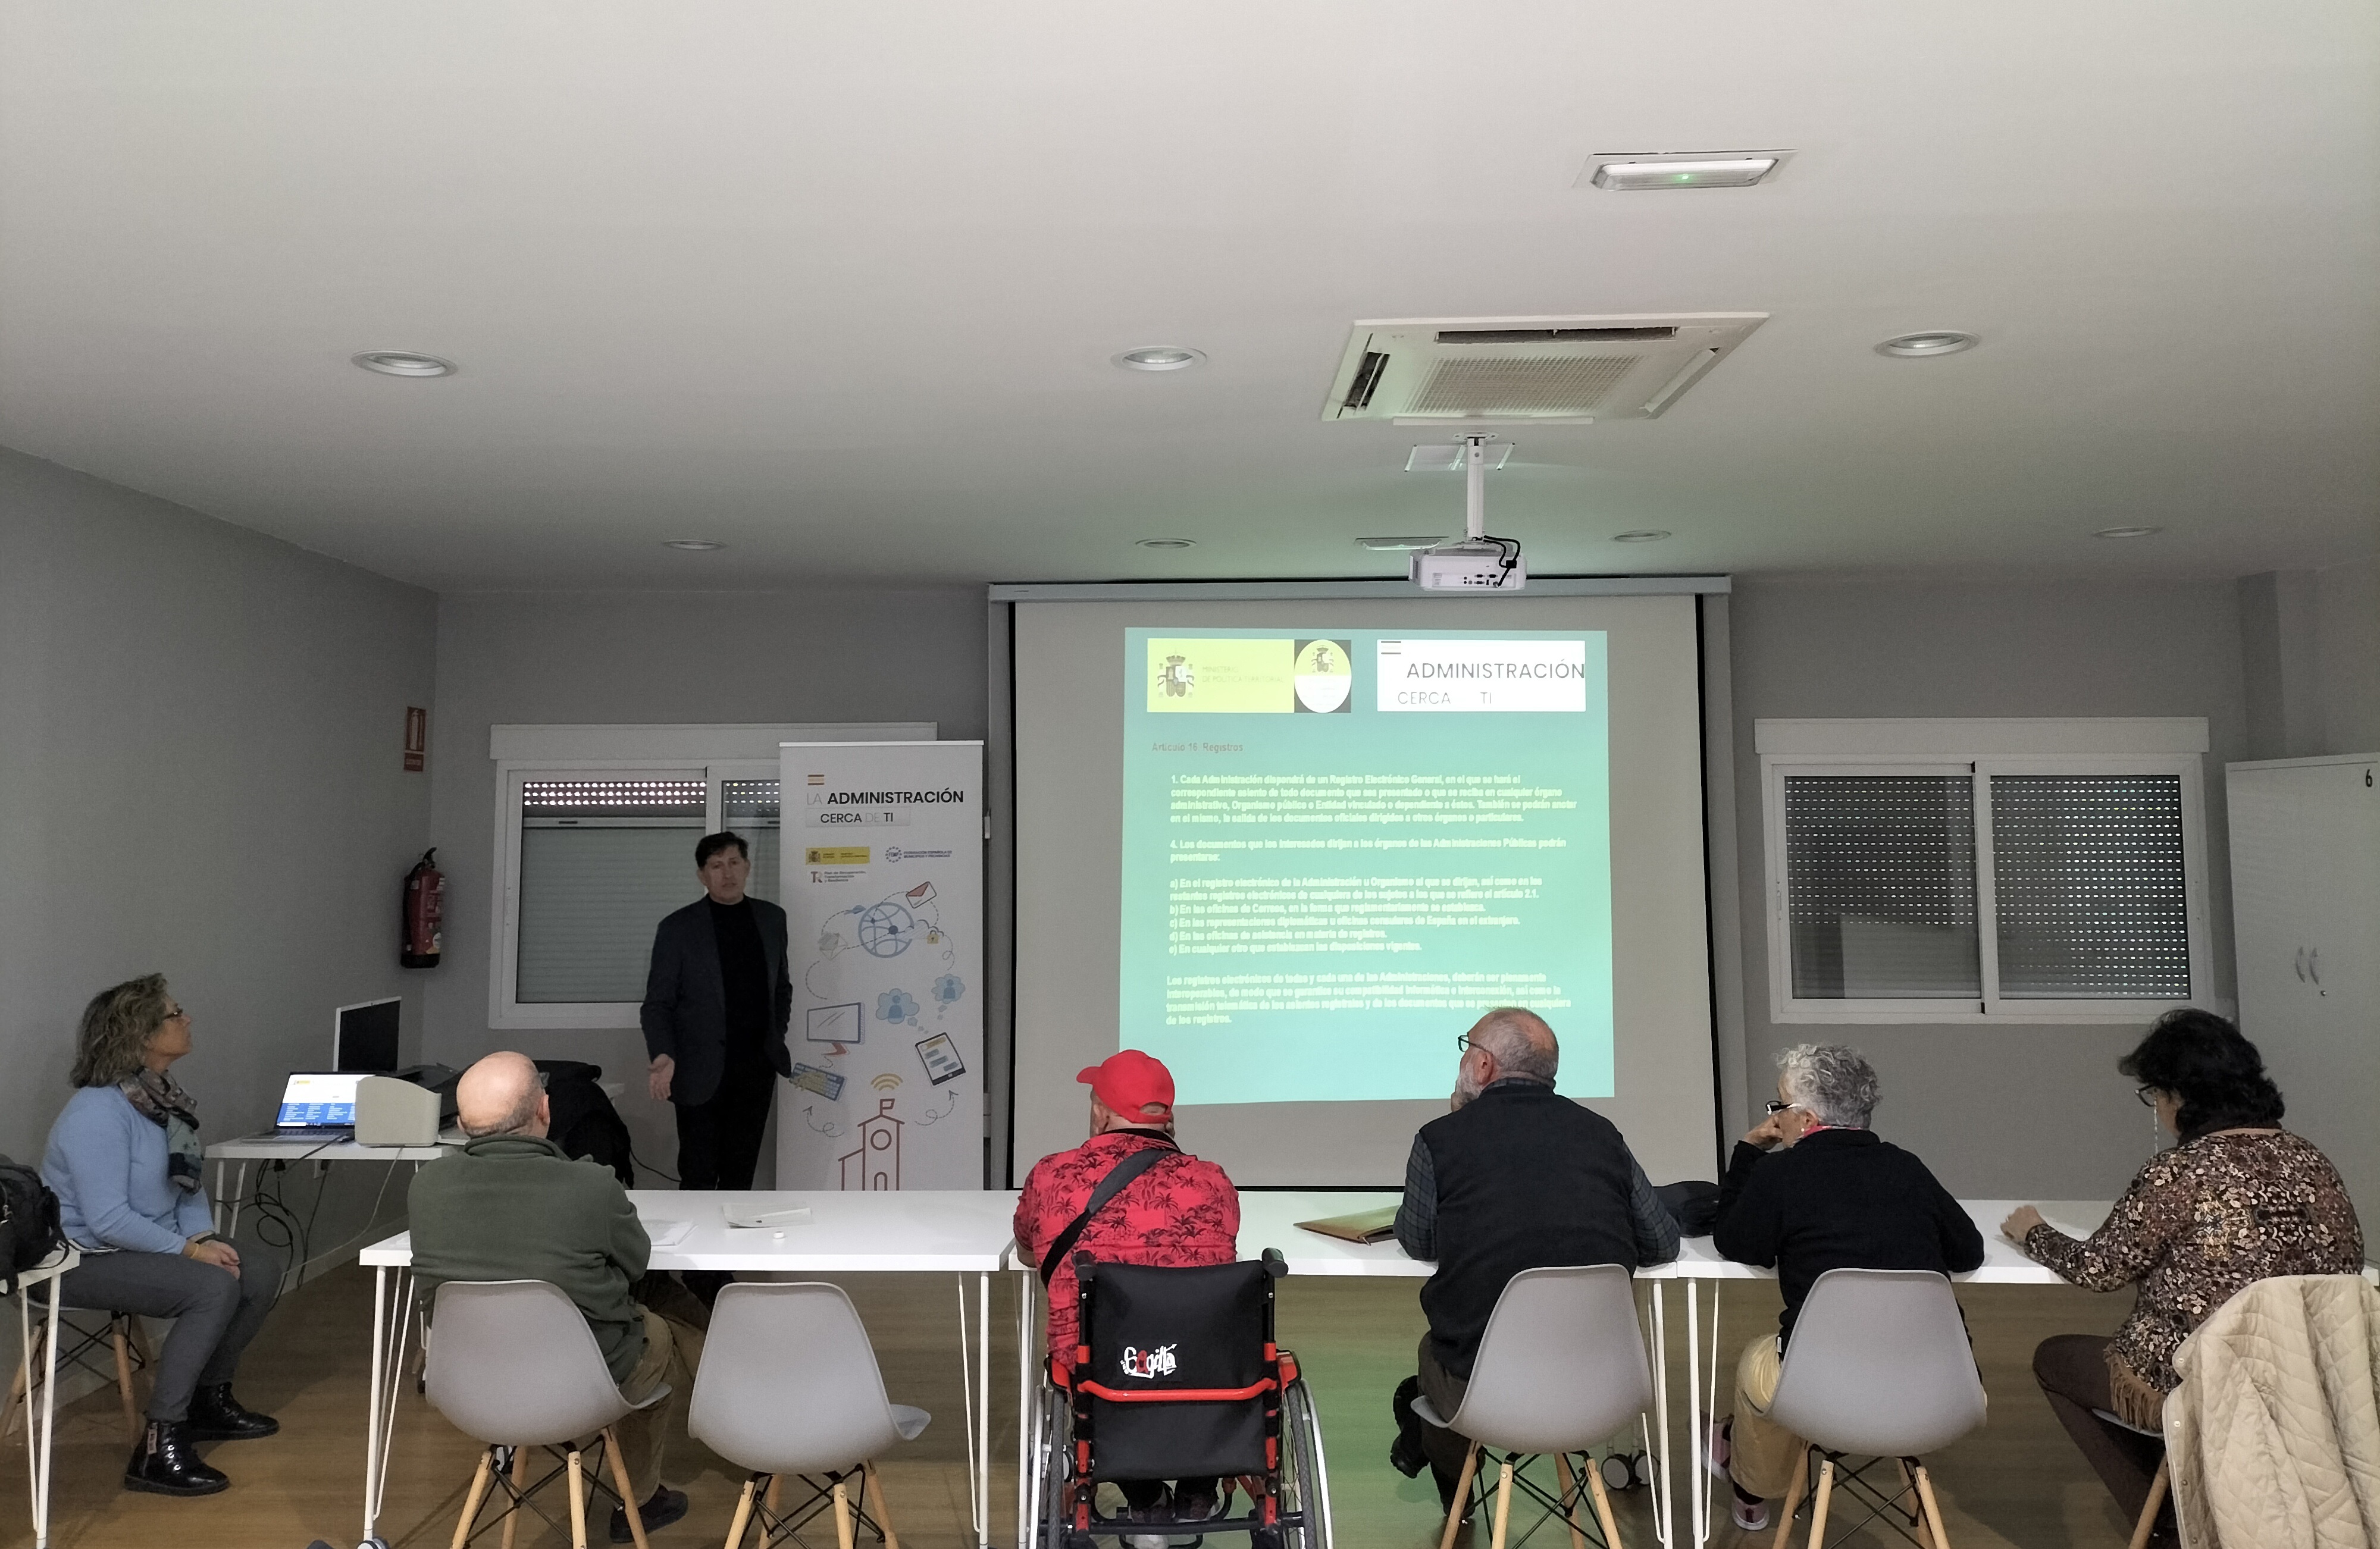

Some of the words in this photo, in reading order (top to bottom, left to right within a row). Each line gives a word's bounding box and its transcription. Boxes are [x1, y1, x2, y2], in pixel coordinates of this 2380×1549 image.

[1407, 659, 1584, 679] ADMINISTRACIÓN
[1398, 692, 1451, 704] CERCA
[1480, 692, 1492, 704] TI
[1202, 742, 1244, 754] Registros
[2365, 769, 2372, 787] 6
[806, 793, 822, 805] LA
[827, 788, 963, 805] ADMINISTRACIÓN
[820, 813, 862, 823] CERCA
[865, 813, 879, 823] DE
[884, 813, 893, 822] TI
[1525, 889, 1539, 898] 2.1.
